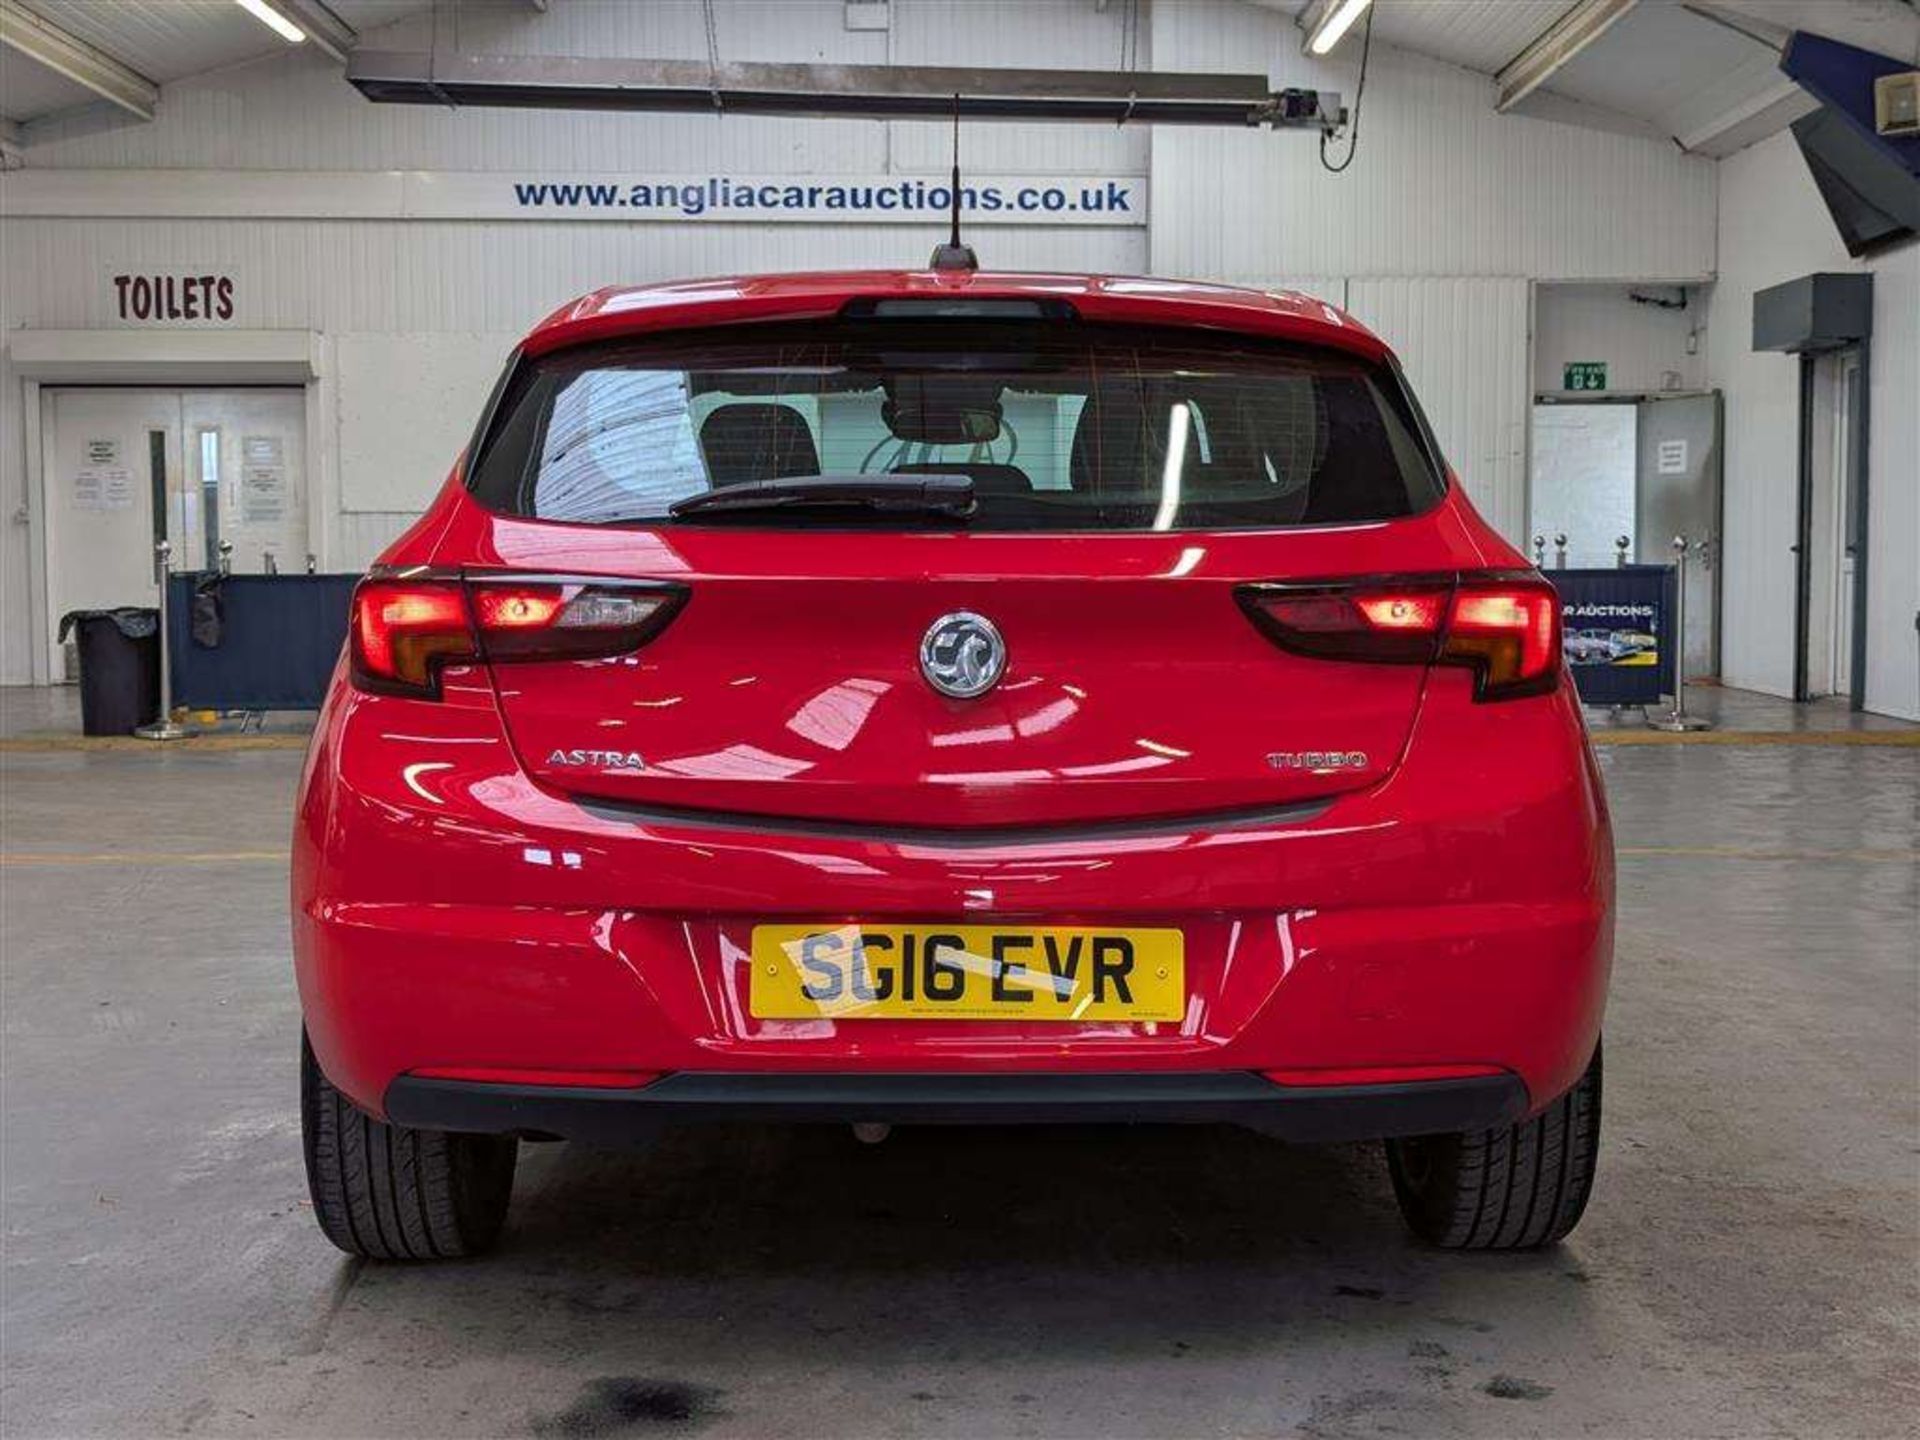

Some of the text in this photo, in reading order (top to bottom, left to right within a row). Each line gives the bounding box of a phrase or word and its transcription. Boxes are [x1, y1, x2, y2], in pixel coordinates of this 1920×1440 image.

[514, 178, 1130, 214] www.angliacarauctions.co.uk
[114, 275, 233, 320] TOILETS
[1576, 605, 1653, 617] AUCTIONS
[546, 749, 644, 769] ASTRA
[1266, 751, 1367, 768] TURBO
[800, 933, 1134, 1004] SG16 EVR
